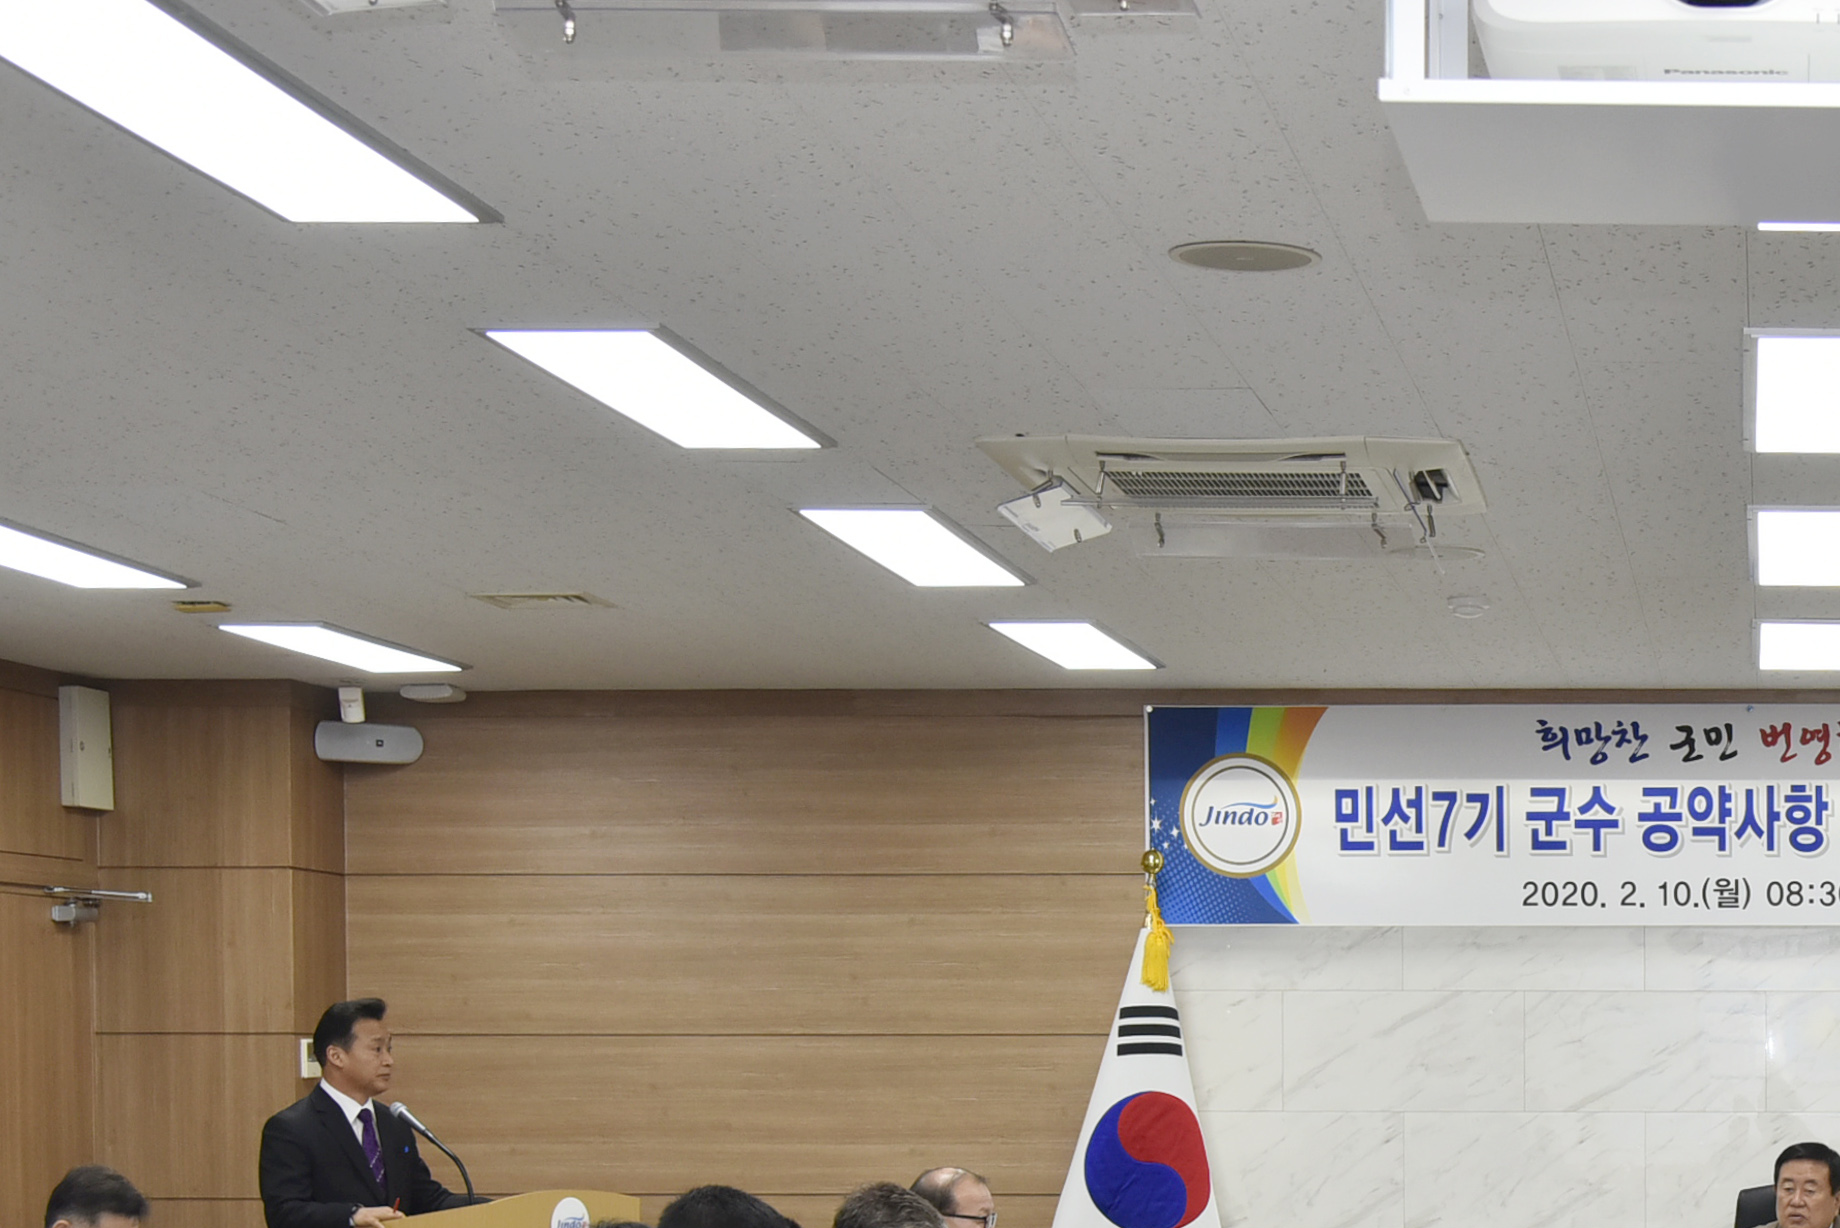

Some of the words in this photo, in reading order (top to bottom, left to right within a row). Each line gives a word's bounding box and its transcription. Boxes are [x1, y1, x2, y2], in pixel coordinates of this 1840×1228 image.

[1663, 68, 1789, 76] Panasonic
[1535, 719, 1650, 766] 희망찬
[1669, 722, 1738, 763] 군민
[1198, 805, 1269, 827] Jindo
[1333, 784, 1506, 854] 민선7기
[1524, 784, 1622, 854] 군수
[1636, 784, 1829, 854] 공약사항
[1521, 880, 1607, 908] 2020.
[1619, 880, 1646, 908] 2.
[1658, 876, 1752, 910] 10.(월)
